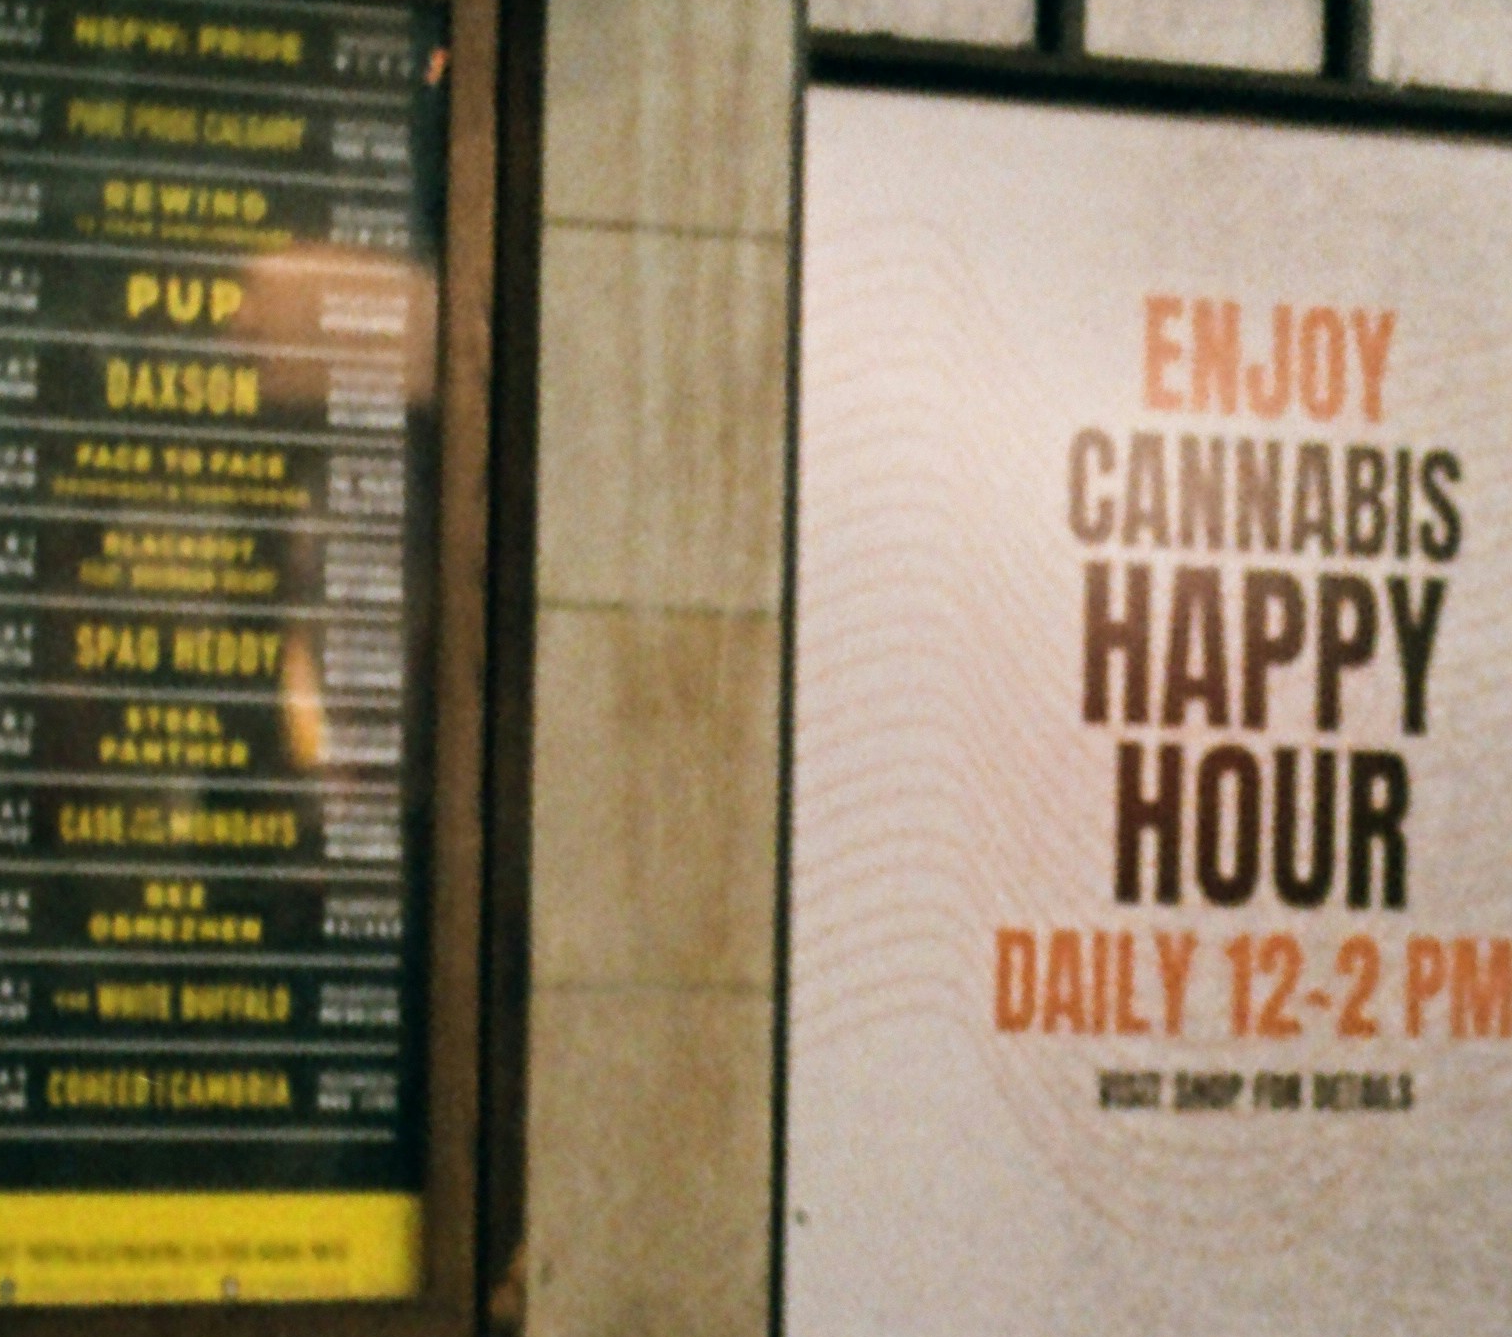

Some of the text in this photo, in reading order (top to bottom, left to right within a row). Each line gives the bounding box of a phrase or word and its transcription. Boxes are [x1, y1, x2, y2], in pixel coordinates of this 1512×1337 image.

[126, 273, 244, 324] PUP
[1141, 294, 1398, 425] ENJOY
[1067, 426, 1464, 563] CANNABIS
[1081, 560, 1448, 737] HAPPY
[1113, 741, 1414, 912] HOUR
[993, 926, 1197, 1036] DAILY
[1226, 932, 1382, 1040] 12-2
